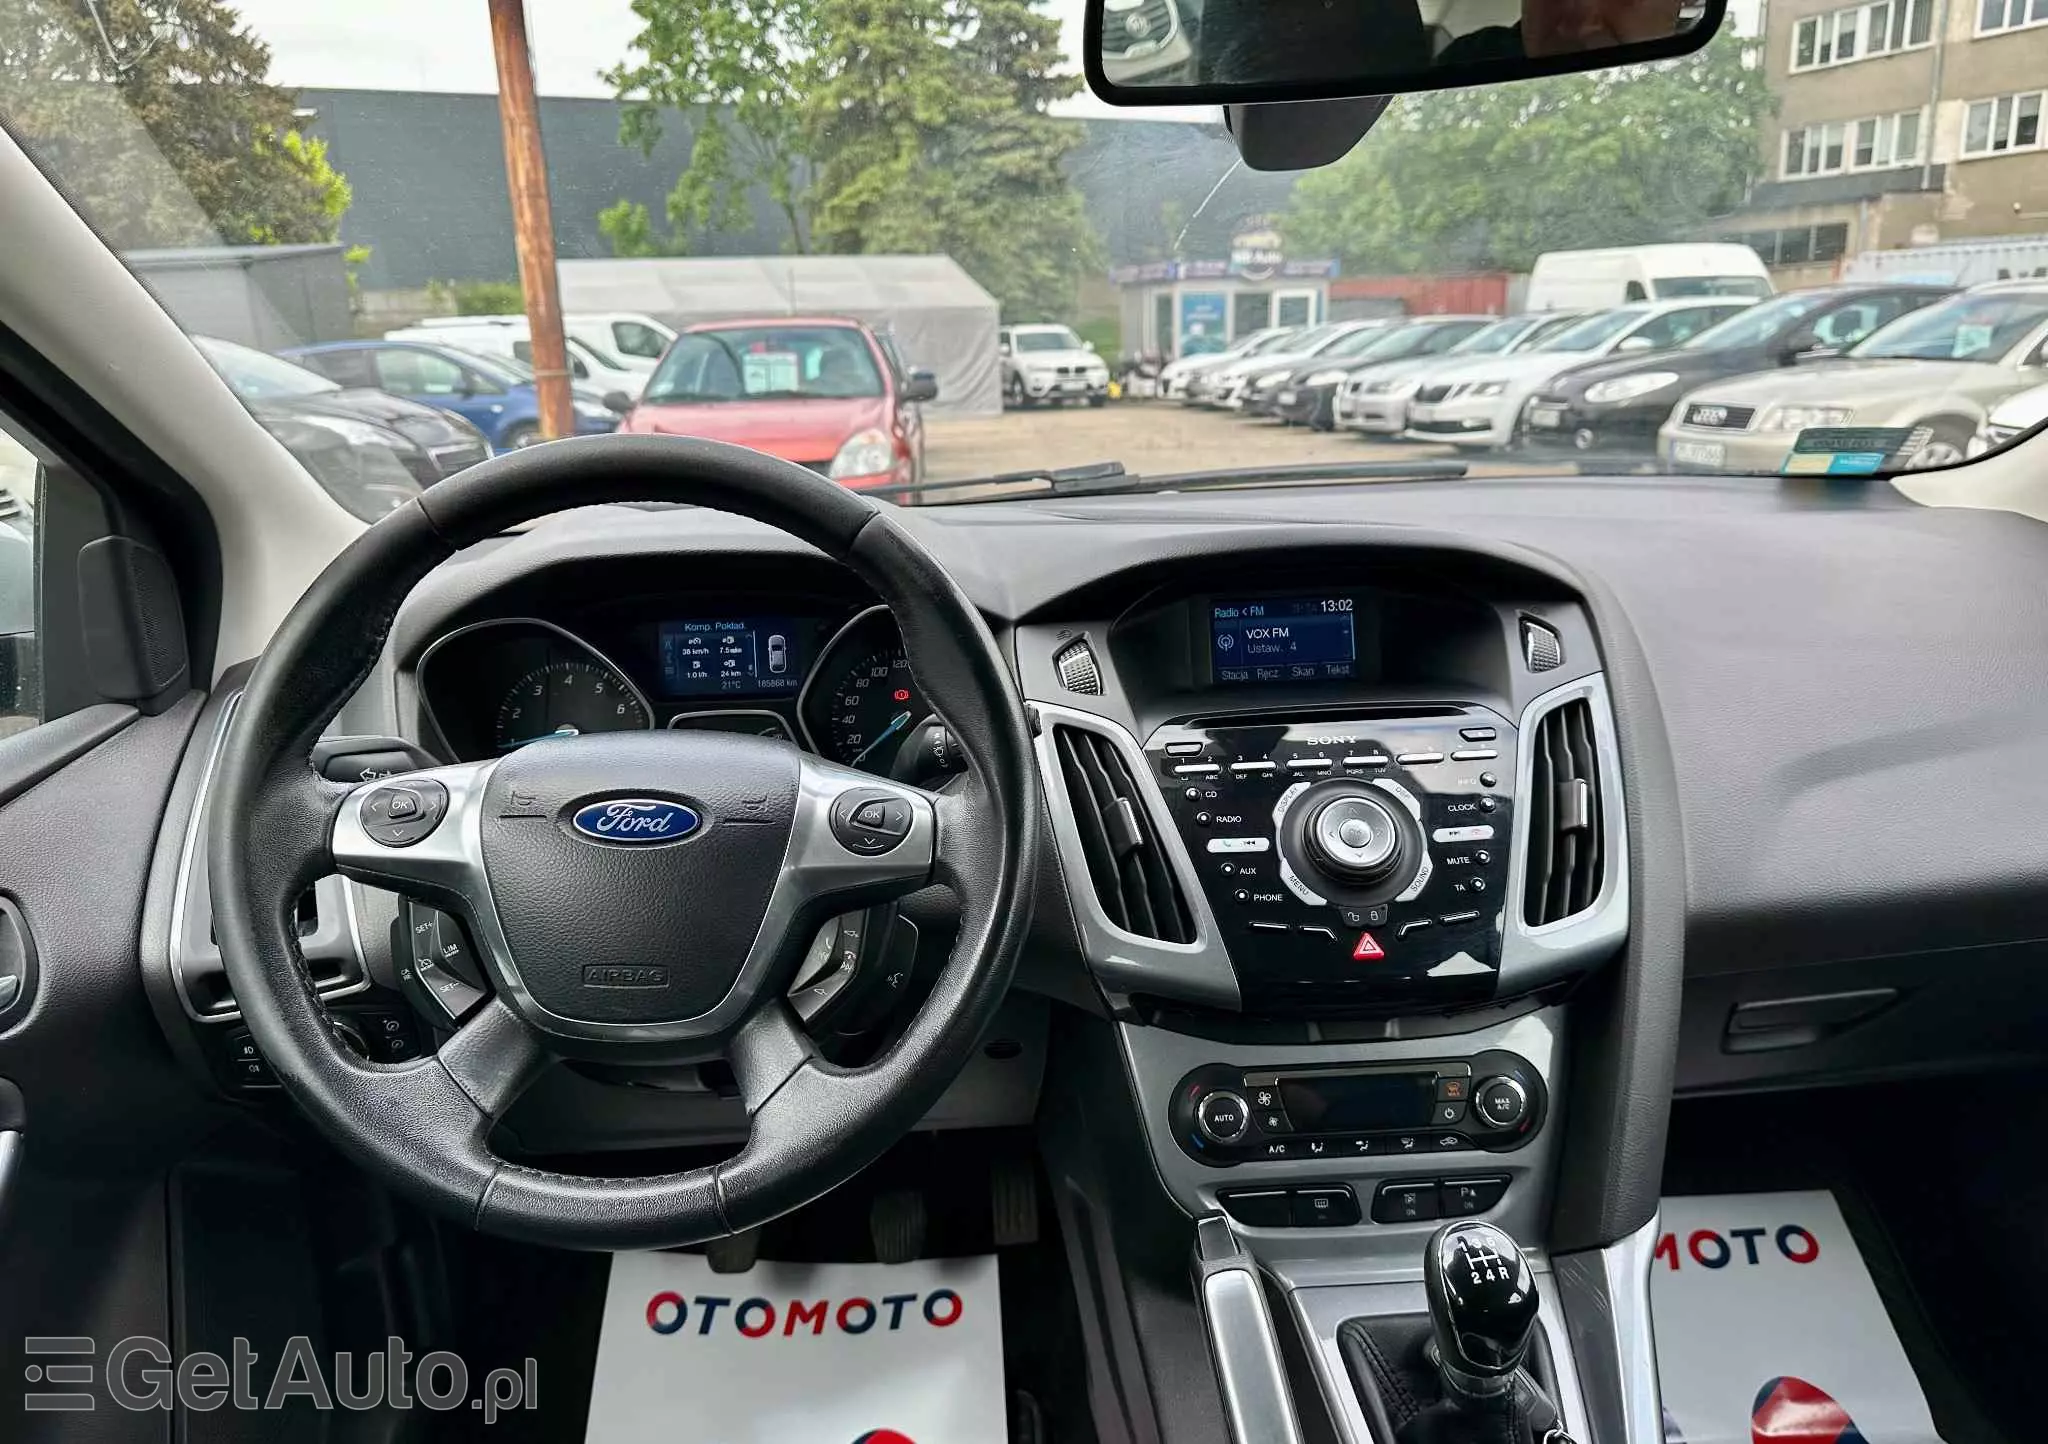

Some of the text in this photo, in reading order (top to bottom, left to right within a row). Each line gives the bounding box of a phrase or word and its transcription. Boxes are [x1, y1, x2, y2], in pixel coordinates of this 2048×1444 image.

[1320, 599, 1353, 612] 13:02
[1214, 606, 1264, 618] Radio FM
[1246, 627, 1289, 639] VOX FM
[1290, 642, 1297, 651] 4
[892, 660, 908, 668] 120
[871, 667, 888, 677] 100
[1292, 666, 1315, 677] Skan
[563, 674, 573, 685] 4
[786, 679, 798, 687] km
[856, 679, 869, 688] 80
[533, 685, 543, 696] 3
[594, 682, 604, 694] 5
[845, 696, 859, 706] 60
[512, 708, 521, 718] 2
[616, 703, 625, 714] 6
[842, 714, 856, 724] 40
[847, 734, 861, 745] 20
[1306, 735, 1357, 746] SONY
[392, 801, 408, 809] OK
[1278, 786, 1299, 814] DISPLAY
[1447, 803, 1477, 812] CLOCK
[597, 803, 675, 832] Ford
[864, 810, 880, 819] OK
[1216, 815, 1242, 823] RADIO
[1446, 856, 1470, 865] MUTE
[1240, 867, 1256, 875] AUX
[1410, 866, 1429, 892] SOUND
[1288, 874, 1309, 896] MENU
[1454, 884, 1466, 892] TA
[1253, 893, 1283, 902] PHONE
[443, 943, 458, 954] LIM
[585, 968, 662, 983] AIRBAG
[1214, 1114, 1234, 1122] AUTO
[1268, 1145, 1286, 1153] A/C
[1471, 1266, 1510, 1285] 2 4 R
[646, 1288, 963, 1339] OTOMOTO
